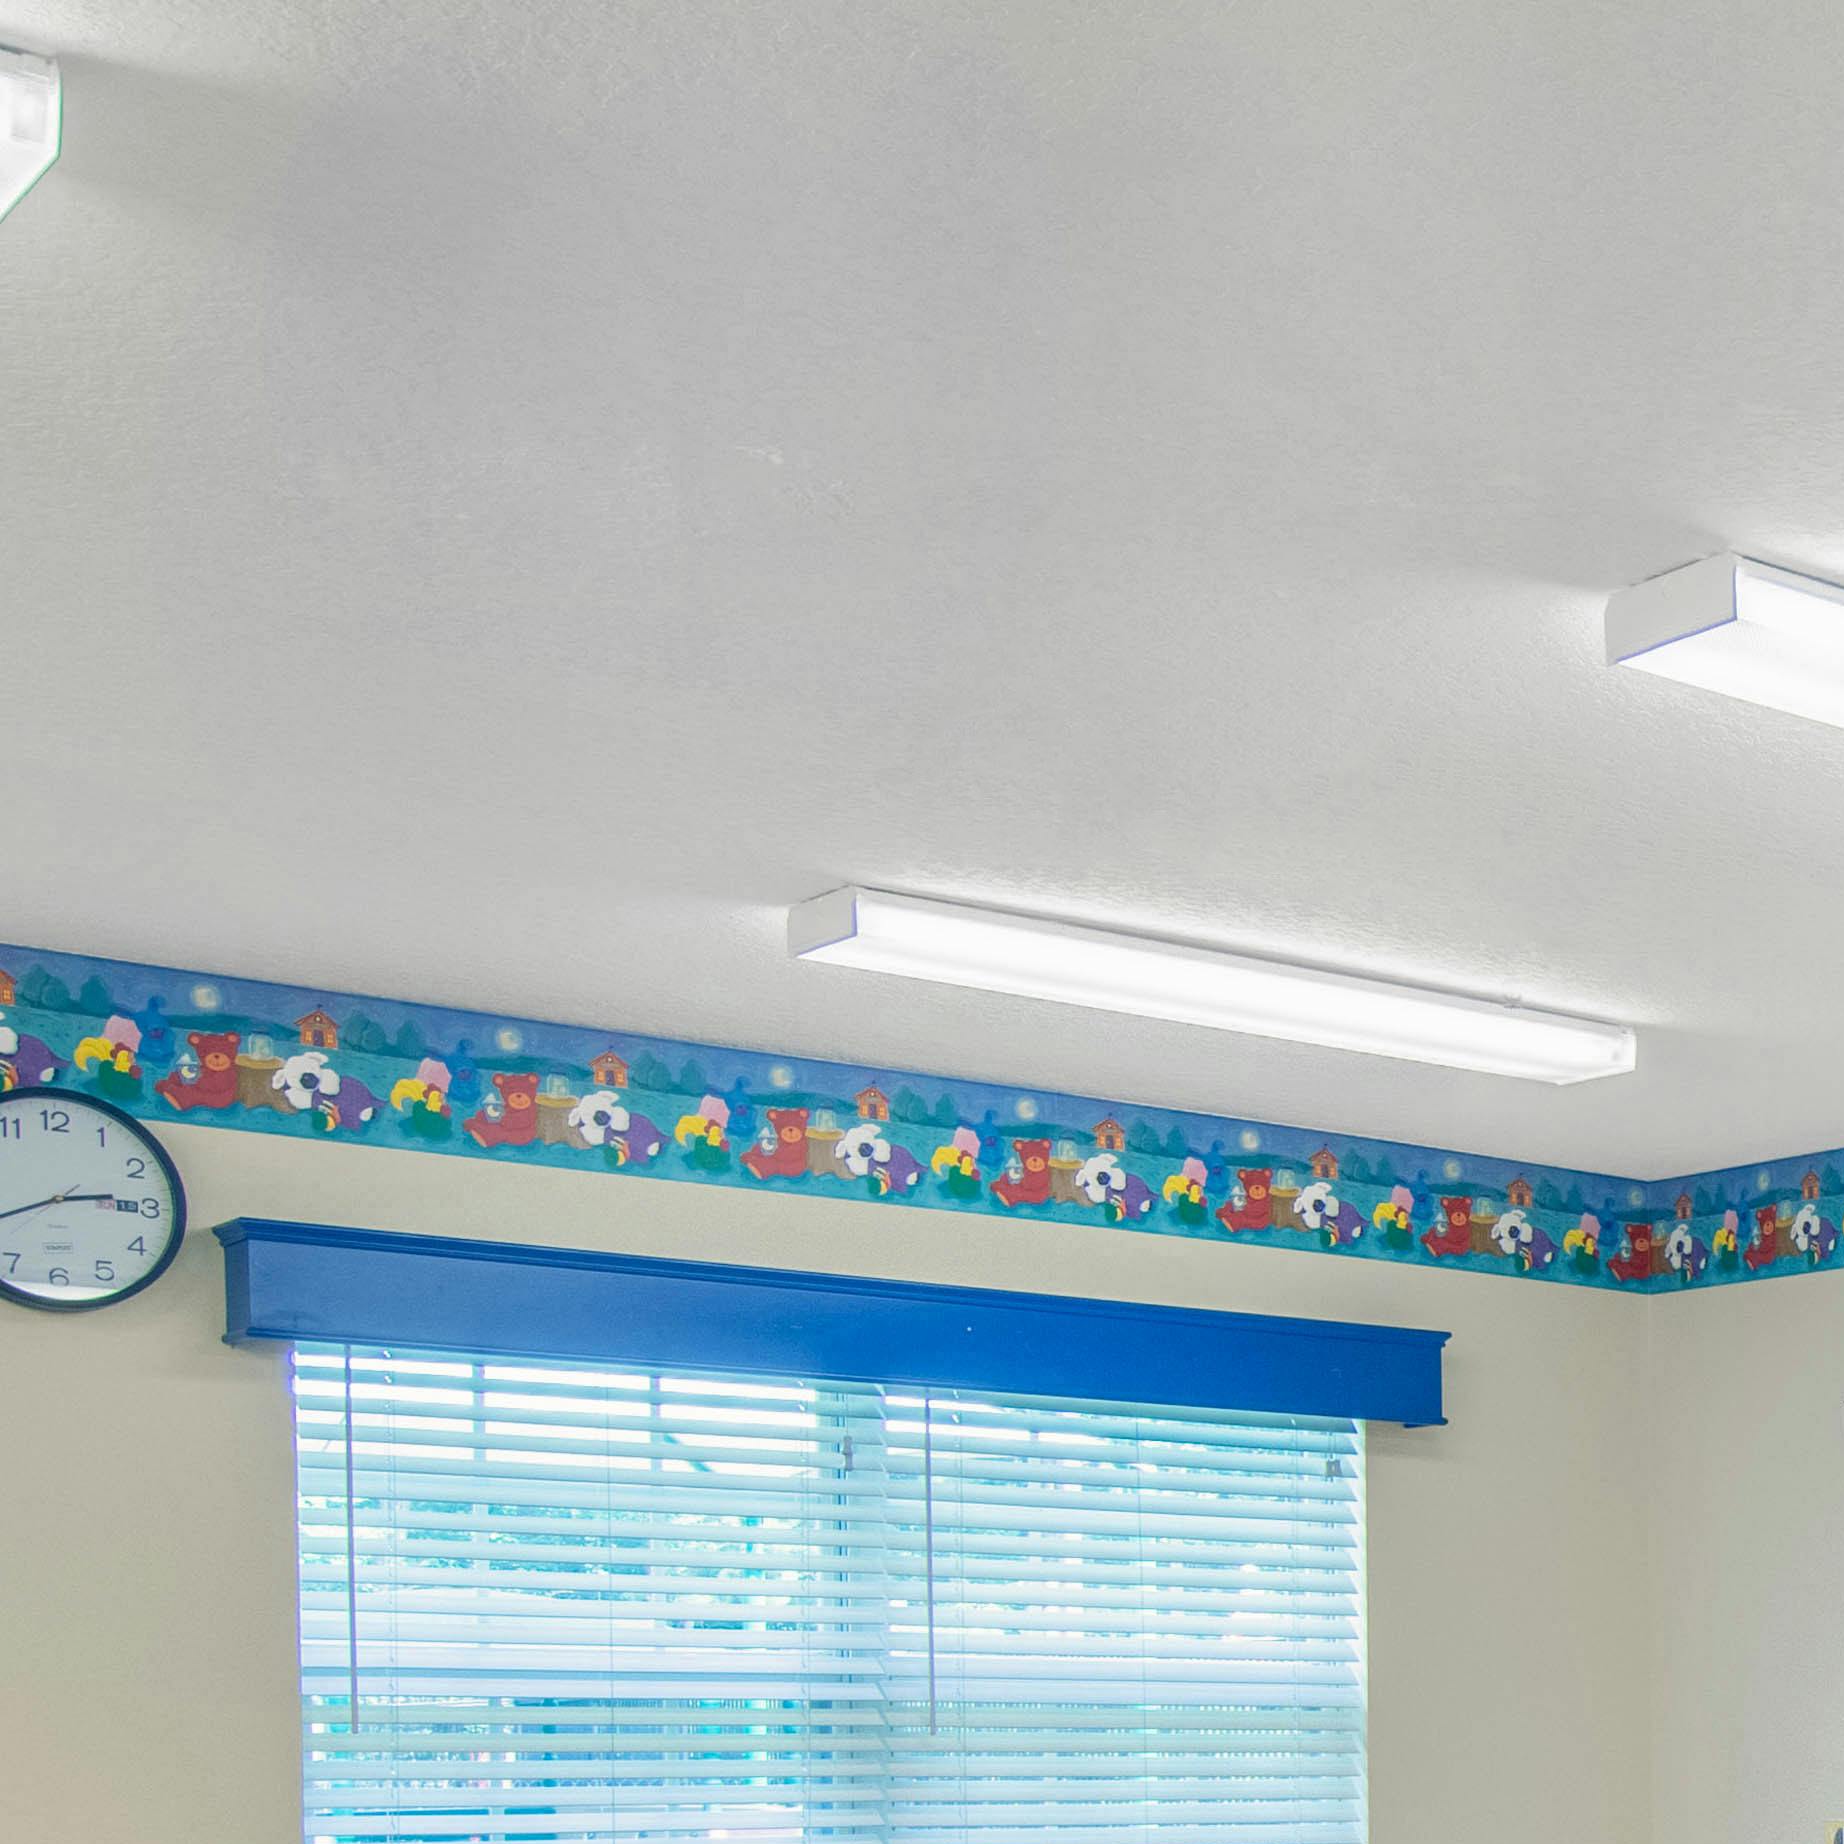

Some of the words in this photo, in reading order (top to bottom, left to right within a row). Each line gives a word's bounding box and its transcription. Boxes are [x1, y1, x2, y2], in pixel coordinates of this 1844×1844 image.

[0, 1116, 21, 1140] 11
[40, 1109, 70, 1133] 12
[97, 1127, 106, 1148] 1
[126, 1158, 146, 1179] 2
[140, 1198, 160, 1219] 3
[127, 1235, 147, 1256] 4
[2, 1252, 21, 1274] 7
[95, 1260, 116, 1282] 5
[49, 1267, 70, 1287] 6
